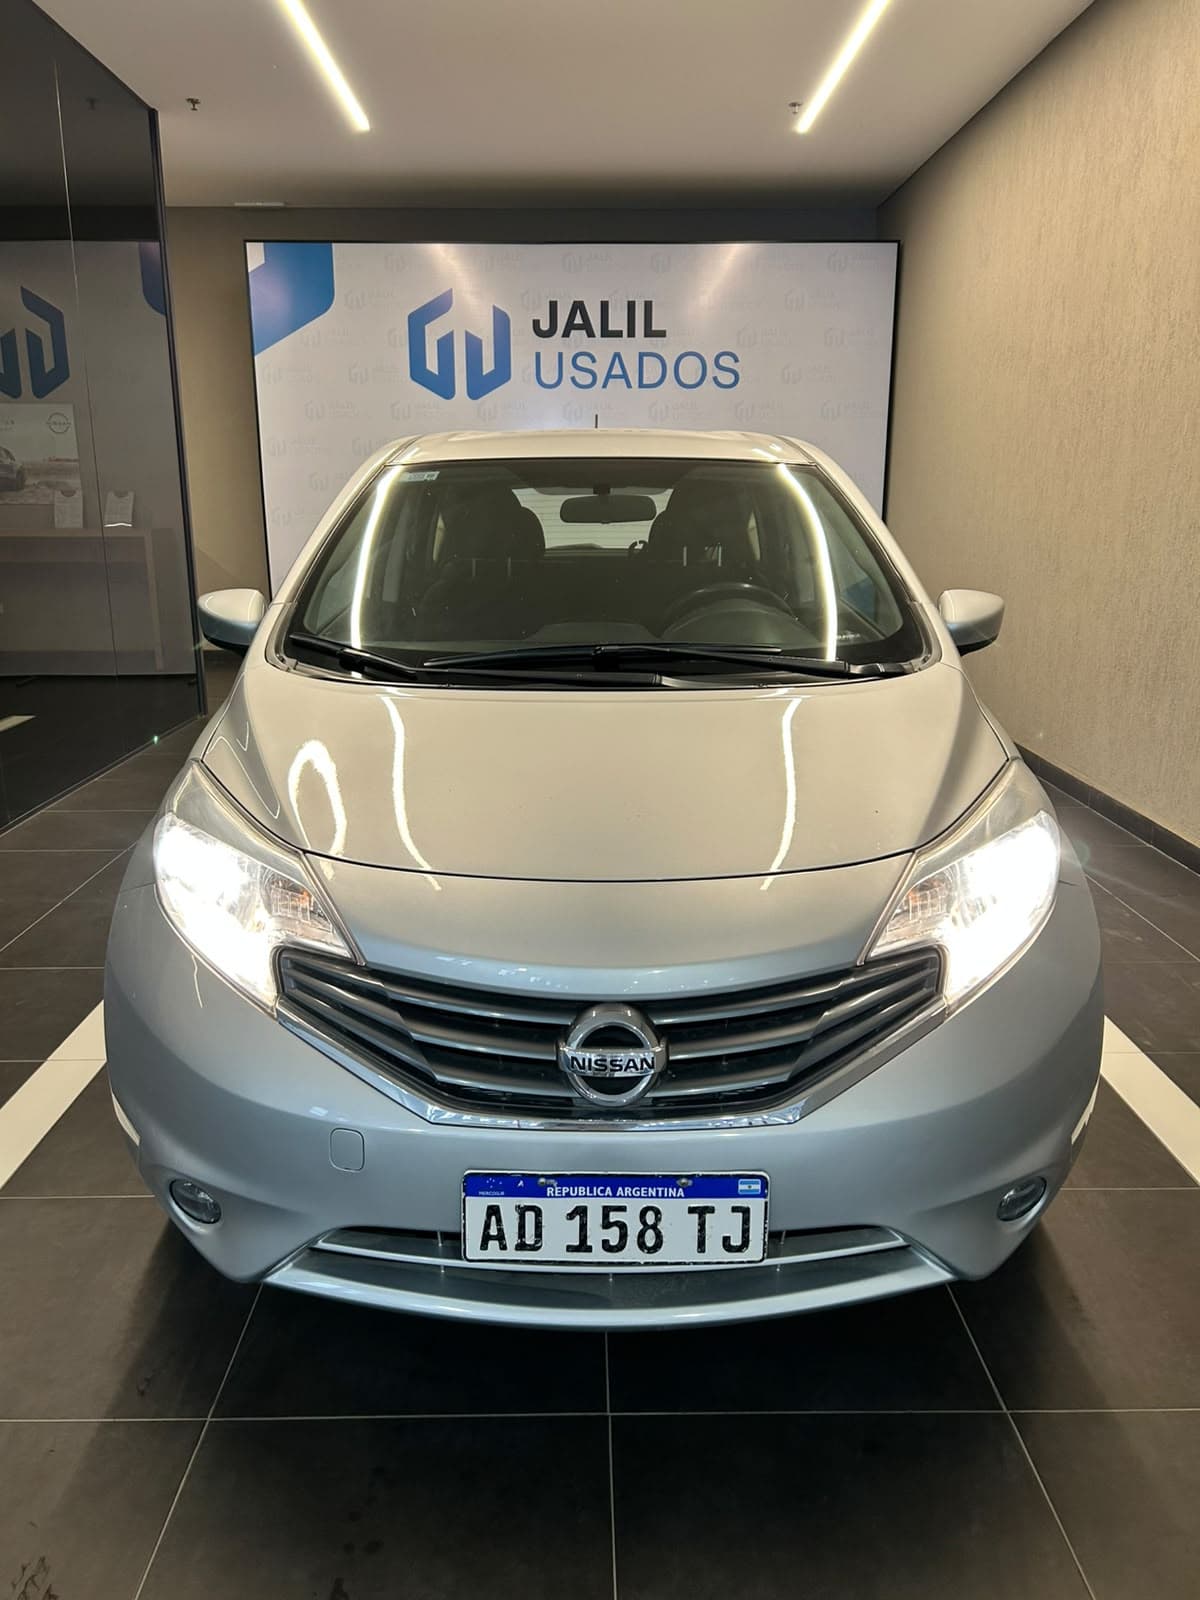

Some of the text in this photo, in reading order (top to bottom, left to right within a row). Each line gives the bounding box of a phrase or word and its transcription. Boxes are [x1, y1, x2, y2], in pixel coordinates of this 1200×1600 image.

[532, 299, 667, 338] JALIL
[535, 350, 741, 390] USADOS
[570, 1056, 655, 1073] NISSAN
[546, 1185, 685, 1198] REPUBLICA ARGENTINA
[479, 1204, 751, 1254] AD 158 TJ
